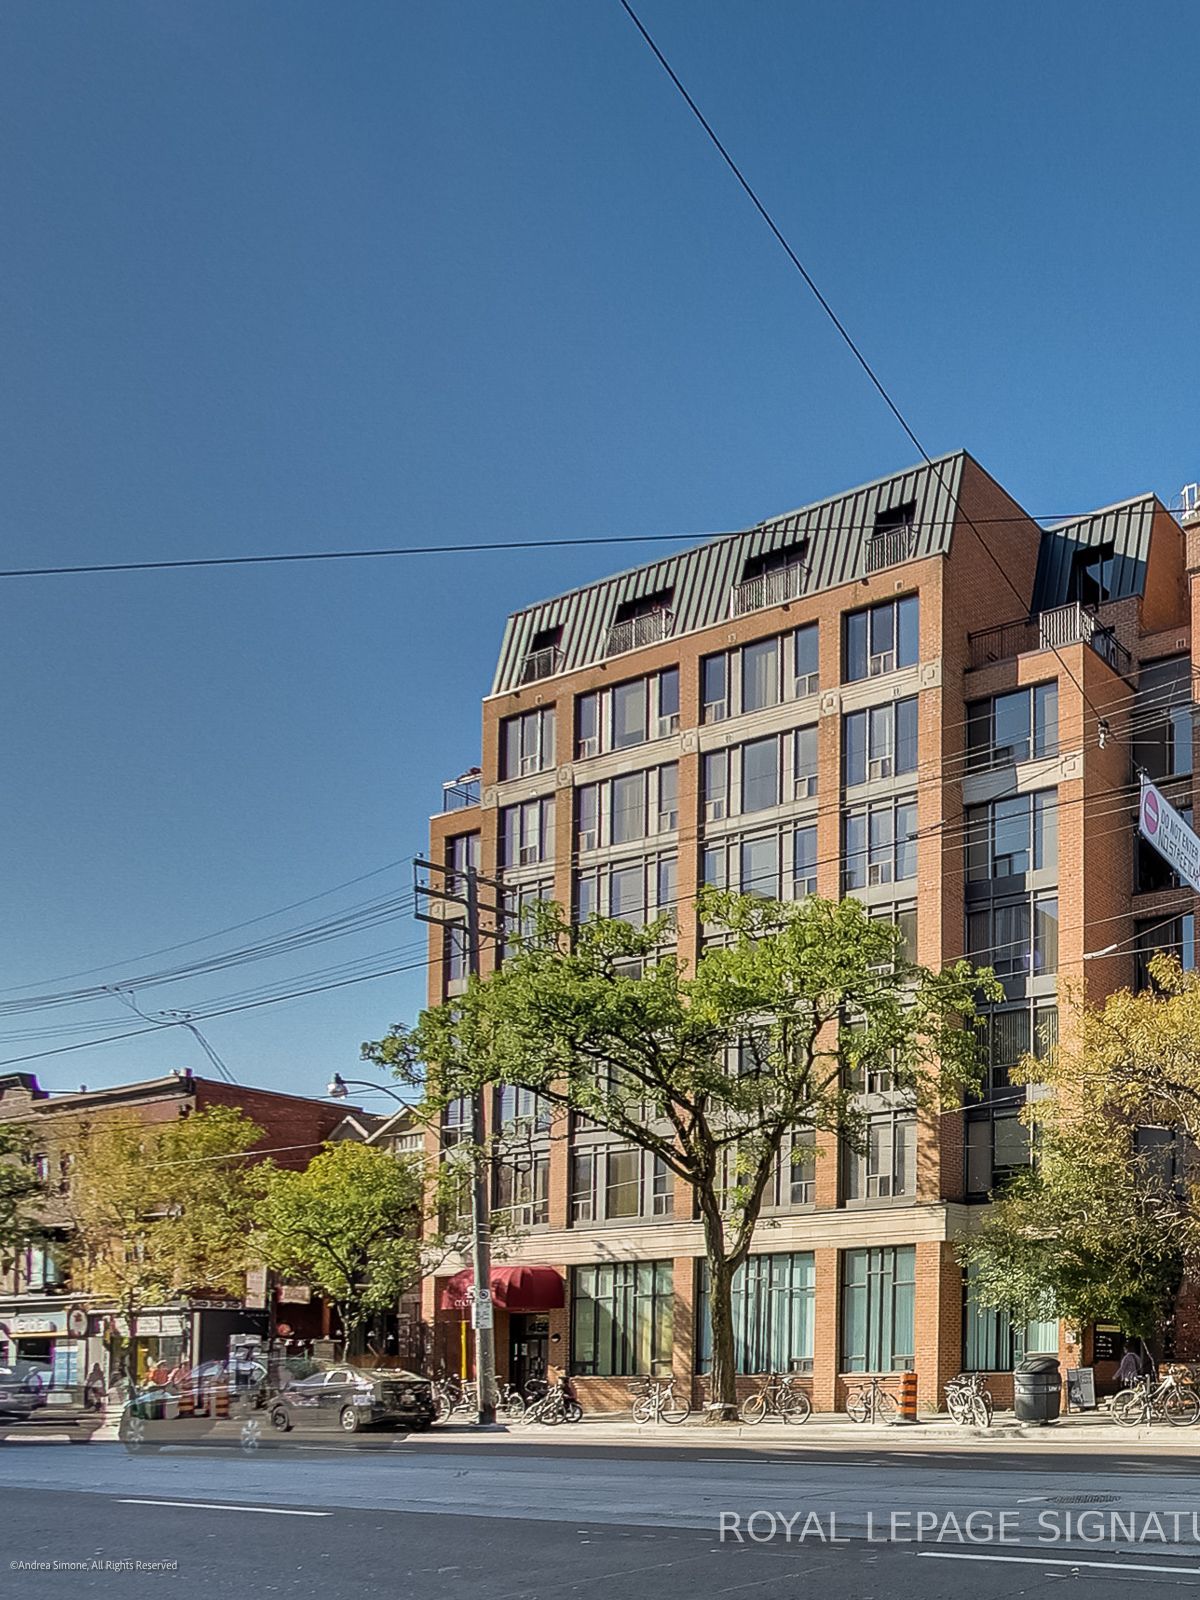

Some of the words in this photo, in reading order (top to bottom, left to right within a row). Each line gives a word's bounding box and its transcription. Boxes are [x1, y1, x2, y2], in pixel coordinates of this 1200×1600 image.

[1161, 809, 1169, 829] DO
[1170, 819, 1181, 840] NOT
[1182, 833, 1199, 862] ENTER
